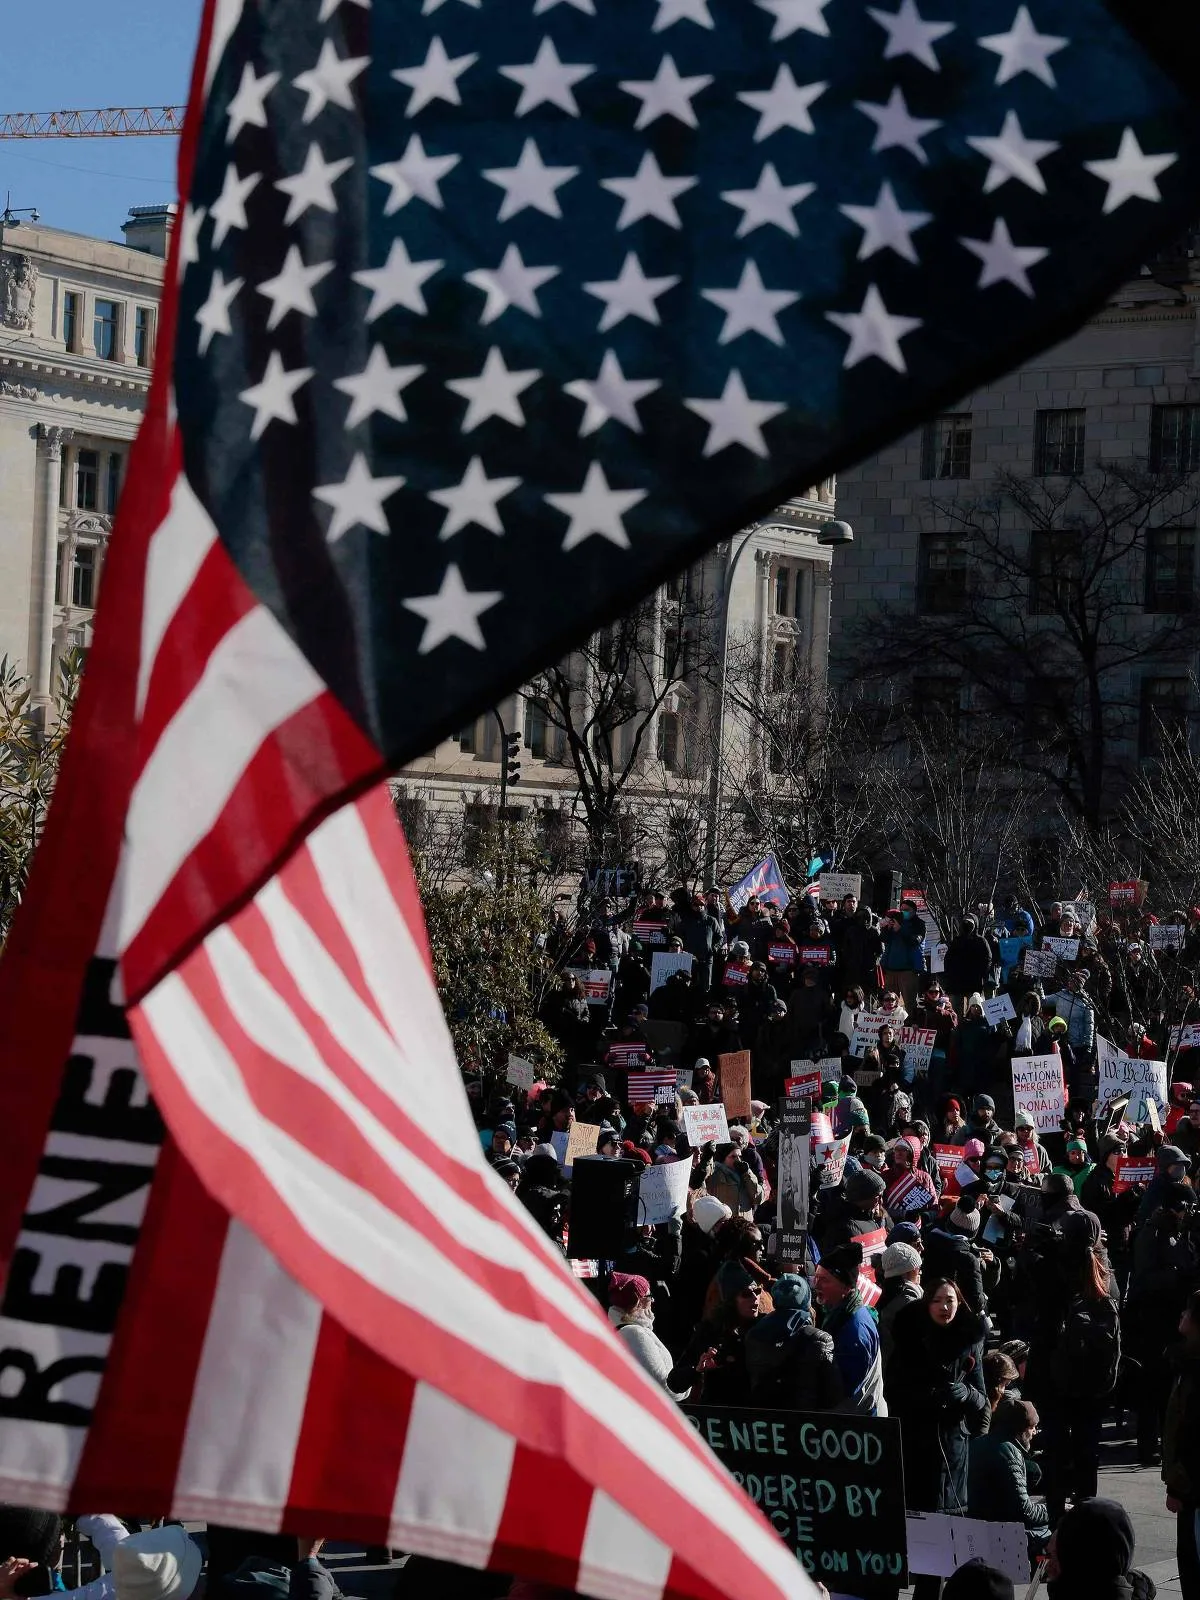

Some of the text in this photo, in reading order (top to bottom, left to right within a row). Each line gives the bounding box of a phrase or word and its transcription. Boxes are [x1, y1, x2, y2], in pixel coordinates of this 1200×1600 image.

[900, 1027, 937, 1046] HATE
[1026, 1060, 1048, 1069] THE
[1104, 1060, 1120, 1080] We
[1014, 1069, 1061, 1083] NATIONAL
[1014, 1079, 1062, 1093] EMERGENCY
[1035, 1090, 1045, 1098] IS
[1104, 1087, 1123, 1099] can
[1141, 1087, 1160, 1102] this
[1018, 1098, 1060, 1112] DONALD
[1119, 1174, 1141, 1182] FREE
[800, 1422, 882, 1465] GOOD
[732, 1472, 882, 1518] DERED BY
[771, 1511, 815, 1542] CE
[820, 1551, 848, 1573] ON
[856, 1549, 903, 1576] YOU
